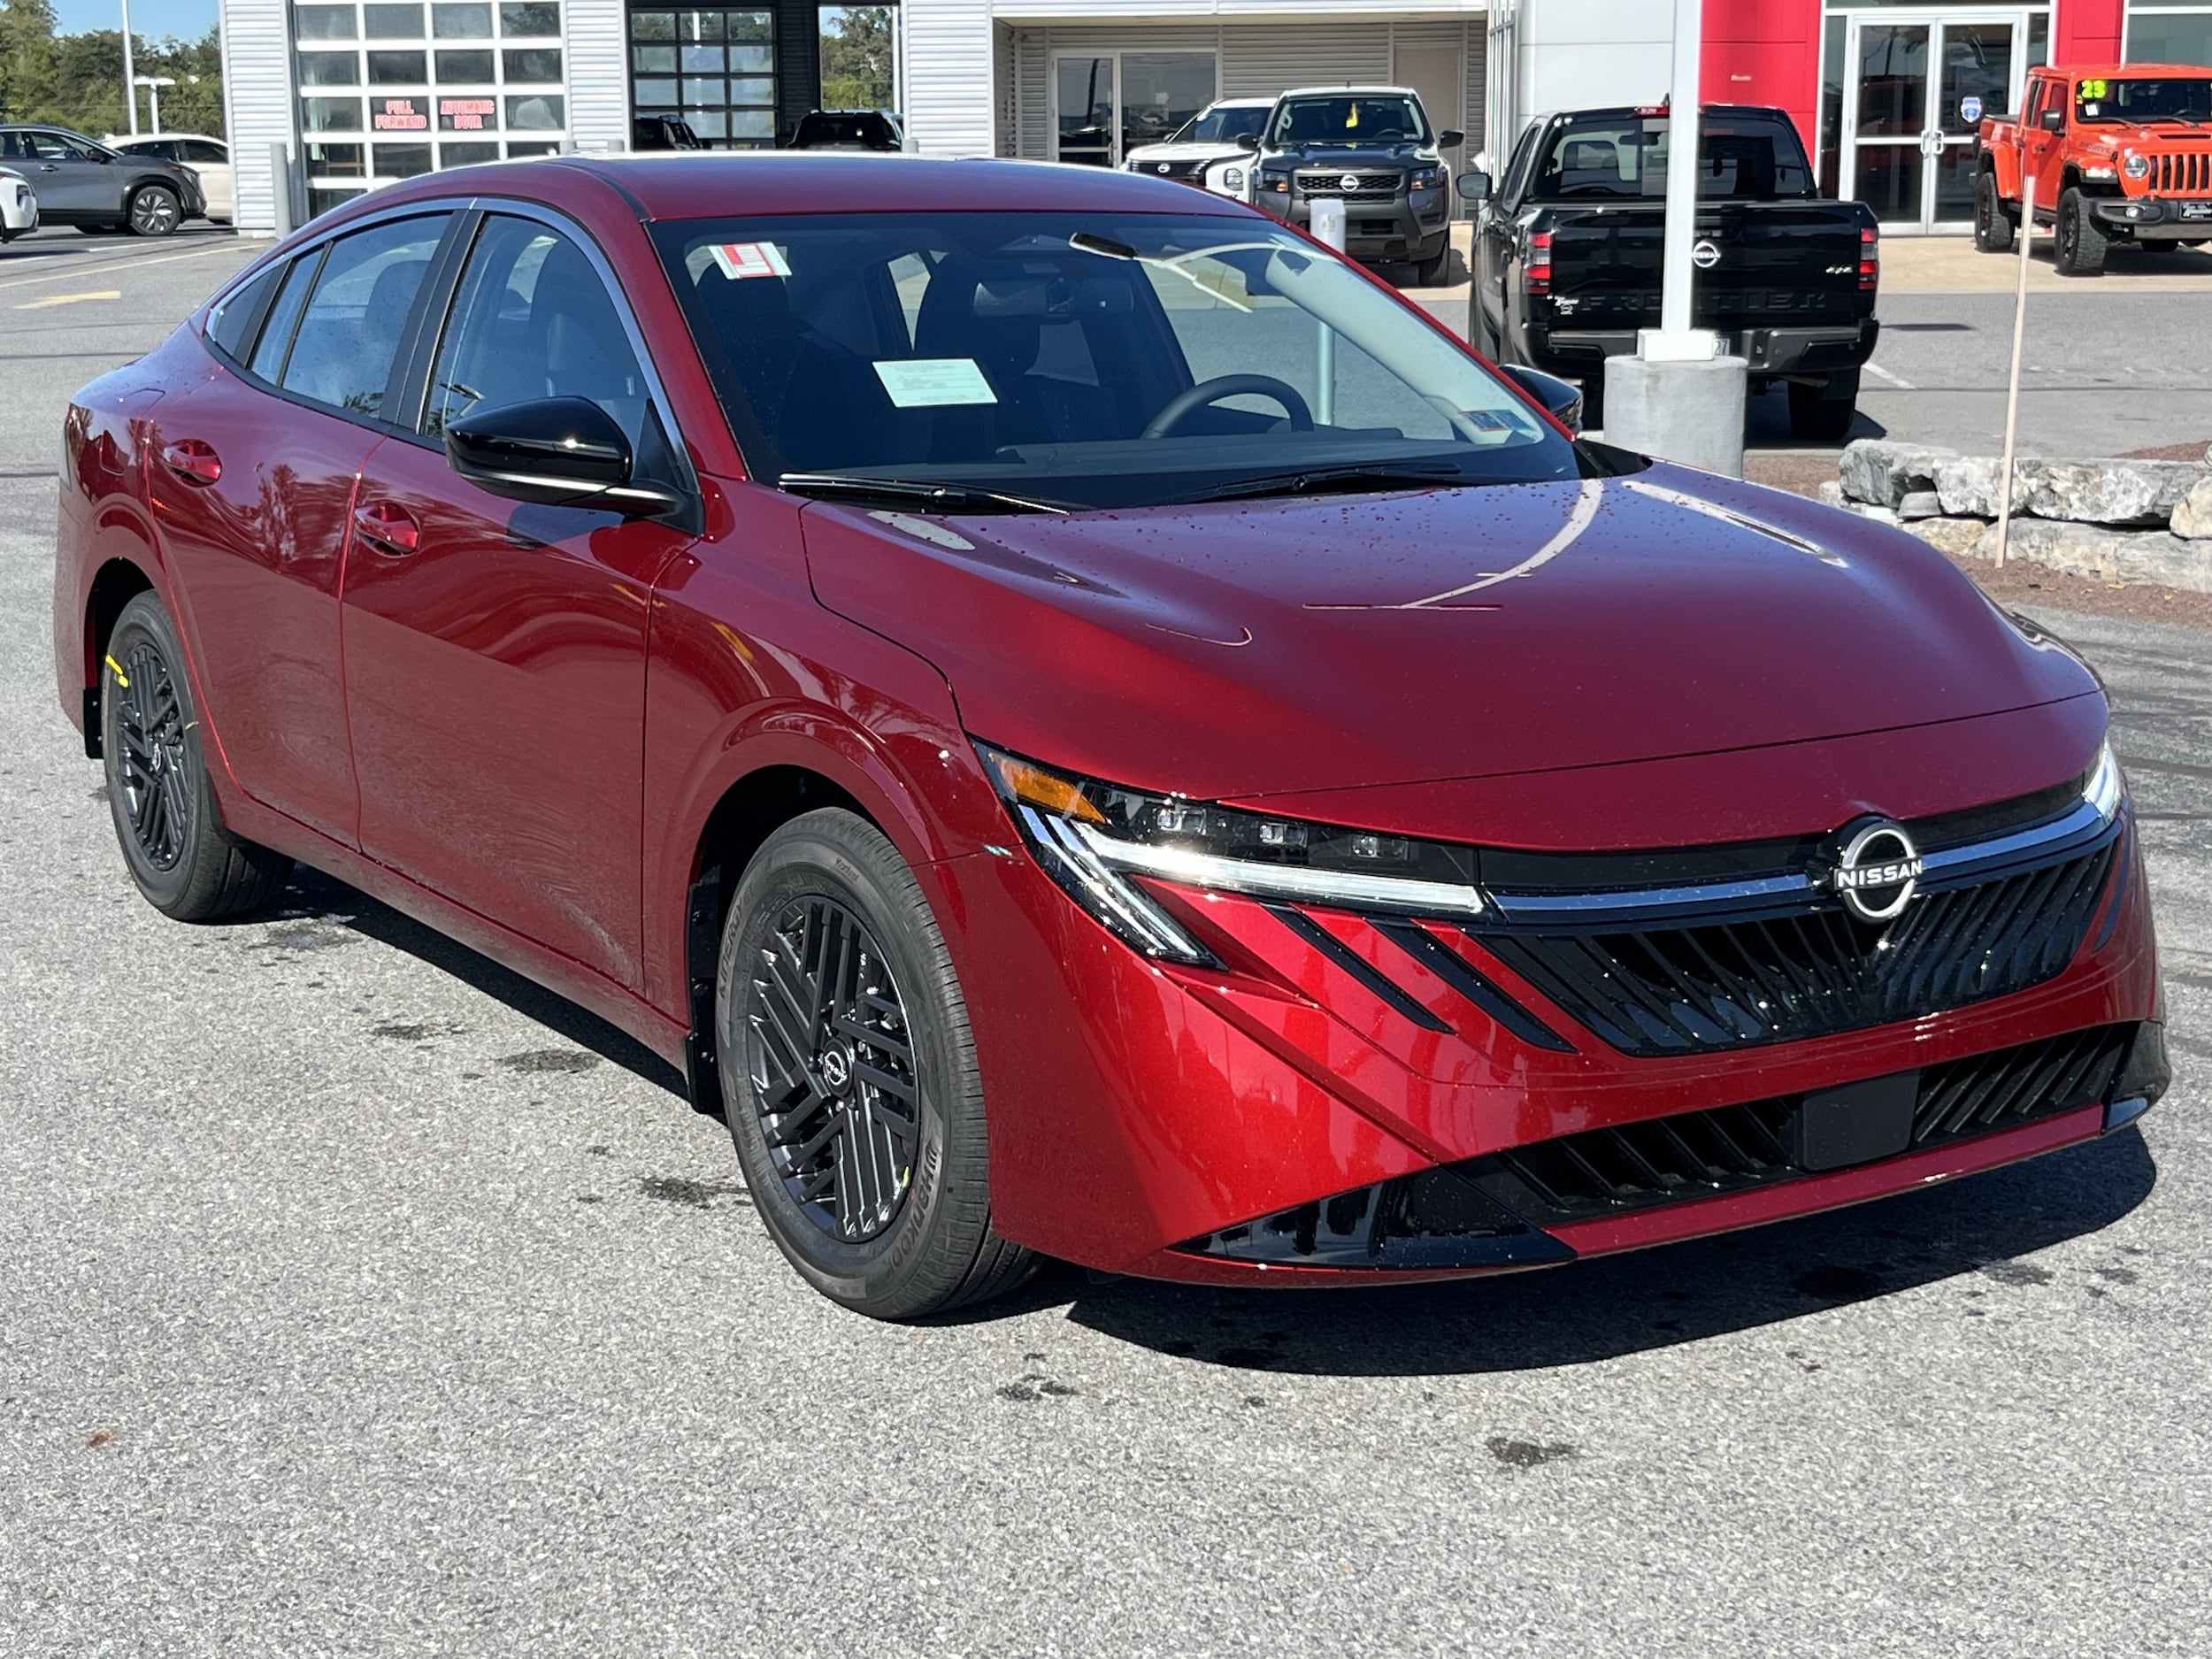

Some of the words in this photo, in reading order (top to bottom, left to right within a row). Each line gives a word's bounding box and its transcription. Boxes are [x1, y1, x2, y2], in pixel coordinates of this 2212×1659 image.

[2081, 80, 2106, 98] 23
[386, 99, 415, 115] PULL
[440, 99, 495, 115] AUTOMATIC
[374, 114, 426, 129] FORWARD
[454, 114, 483, 129] DOOR
[1838, 859, 1922, 887] NISSAN
